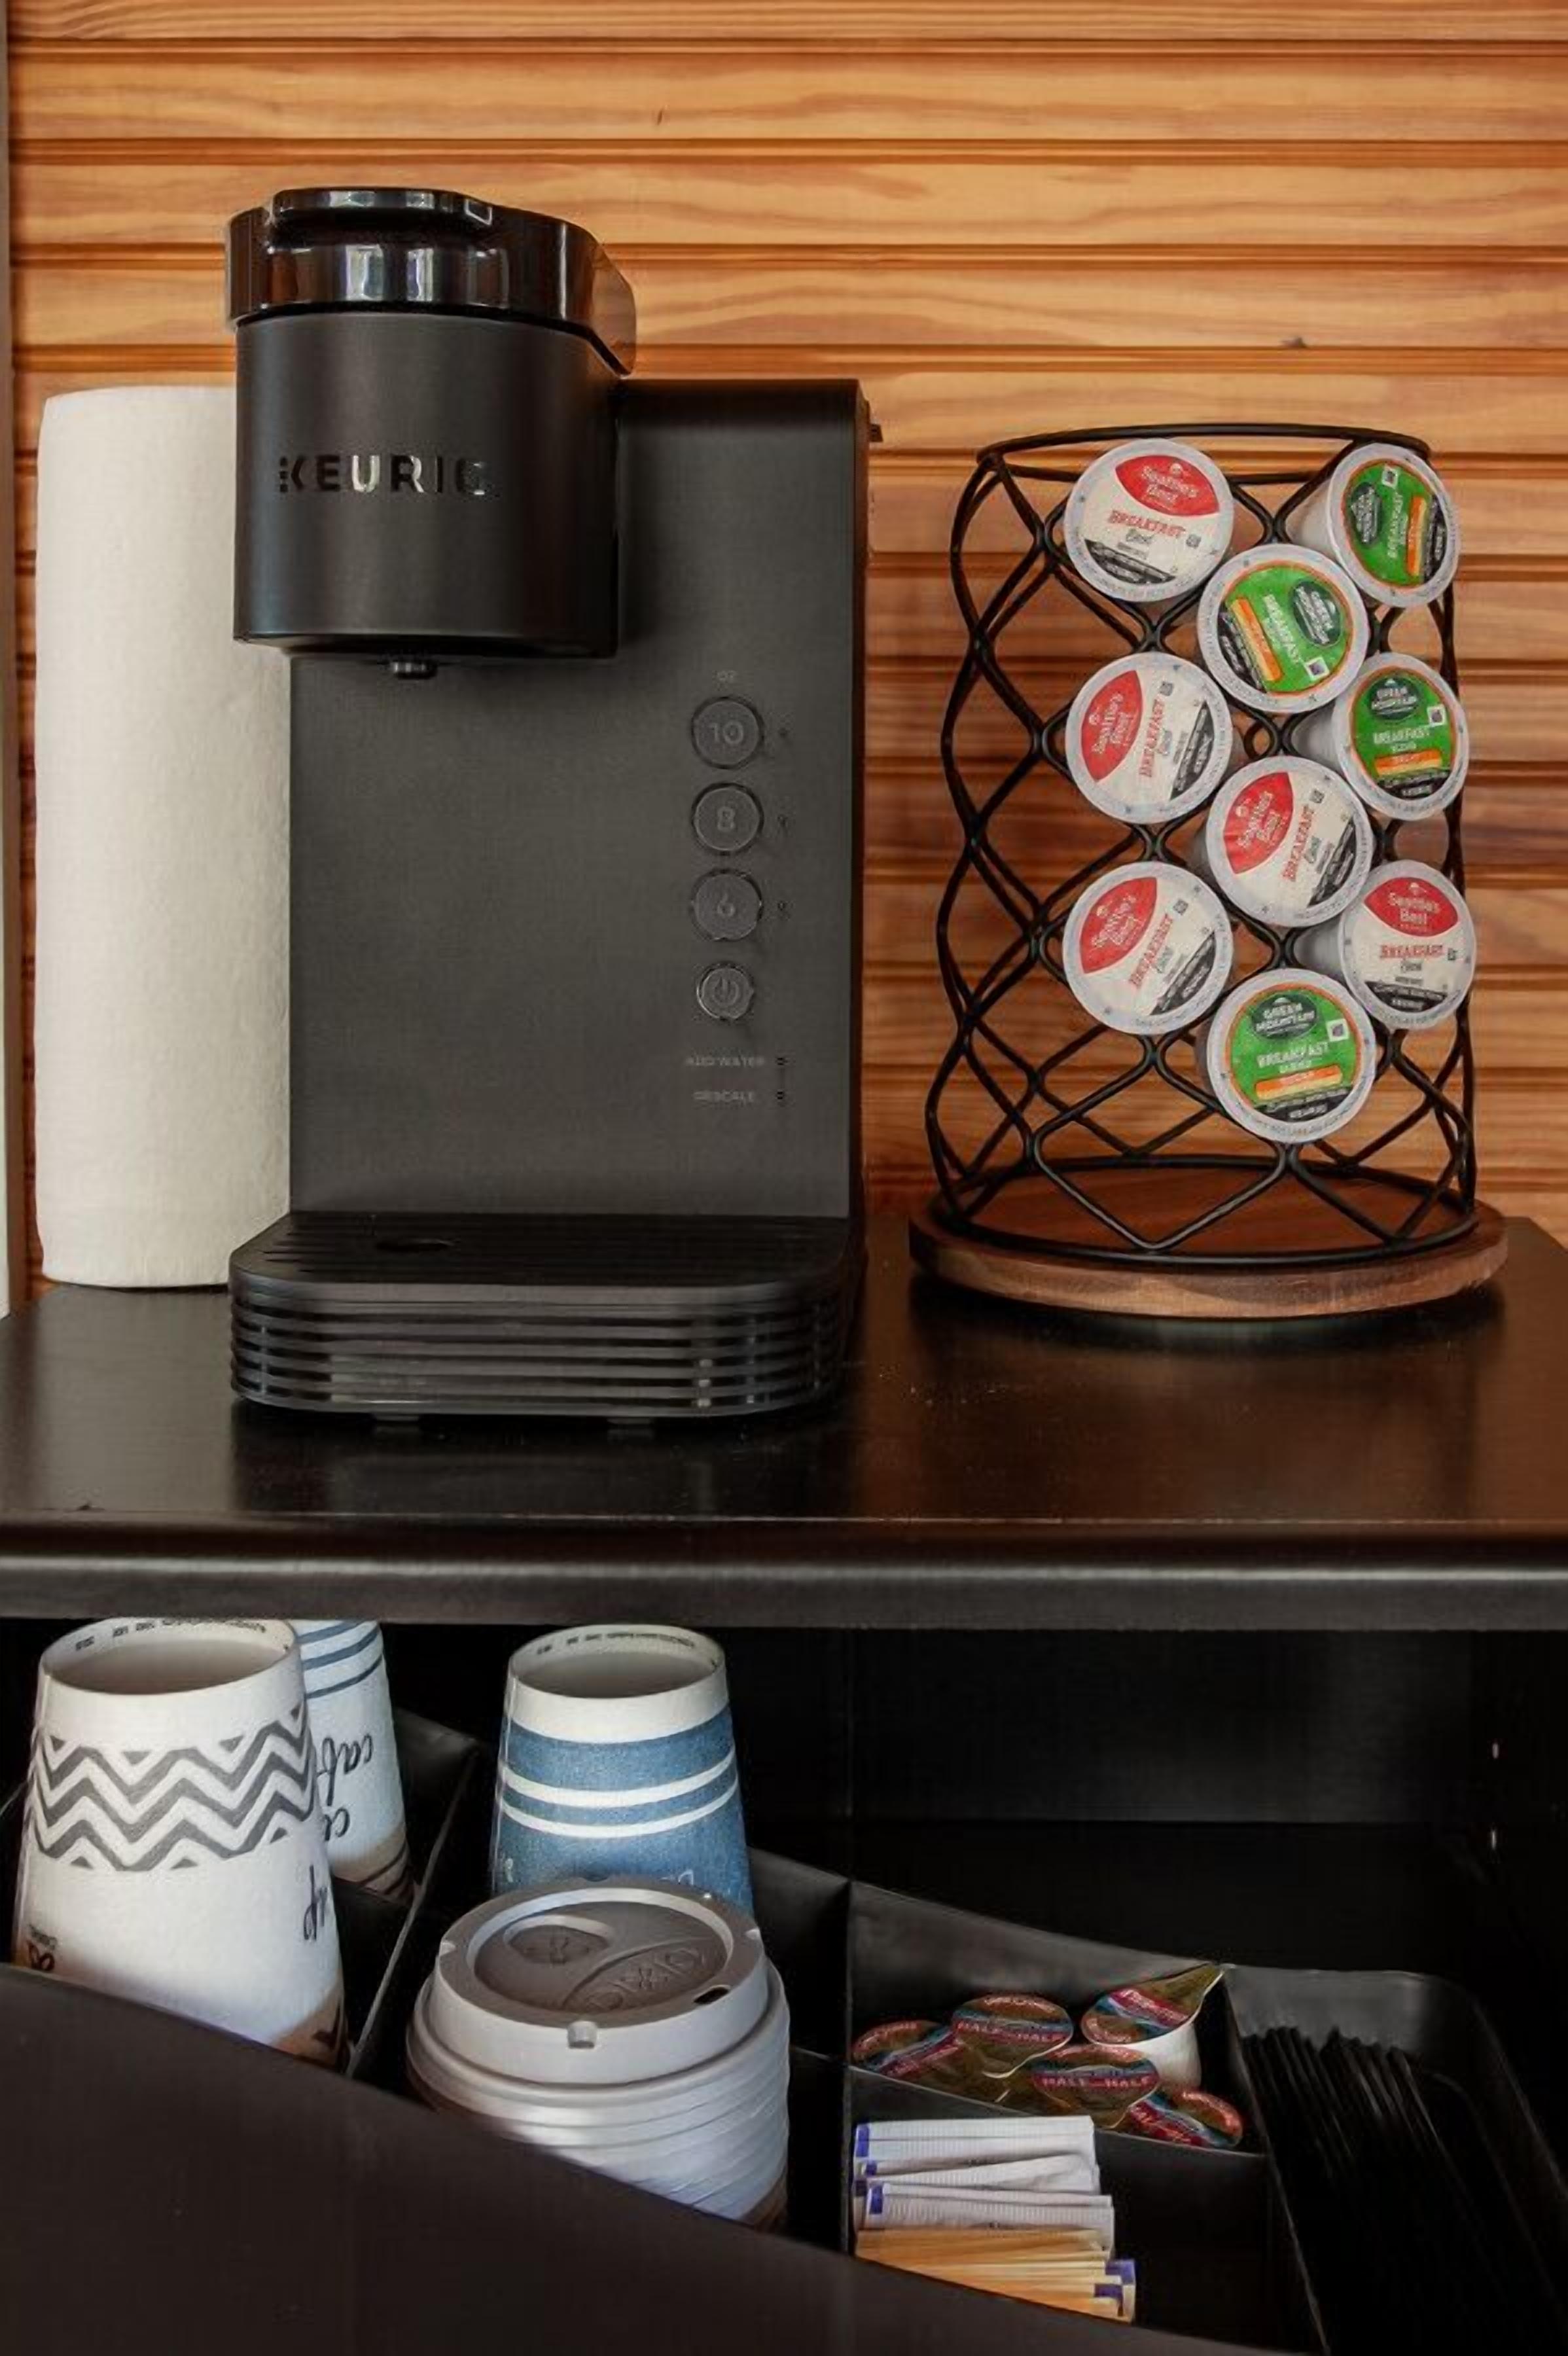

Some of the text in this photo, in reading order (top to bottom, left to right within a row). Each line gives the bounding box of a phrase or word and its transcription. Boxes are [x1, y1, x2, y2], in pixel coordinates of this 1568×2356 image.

[279, 454, 487, 496] KEURIG
[707, 721, 744, 745] 10
[717, 806, 736, 832] 8
[717, 892, 736, 917] 6
[317, 1734, 374, 1807] caf
